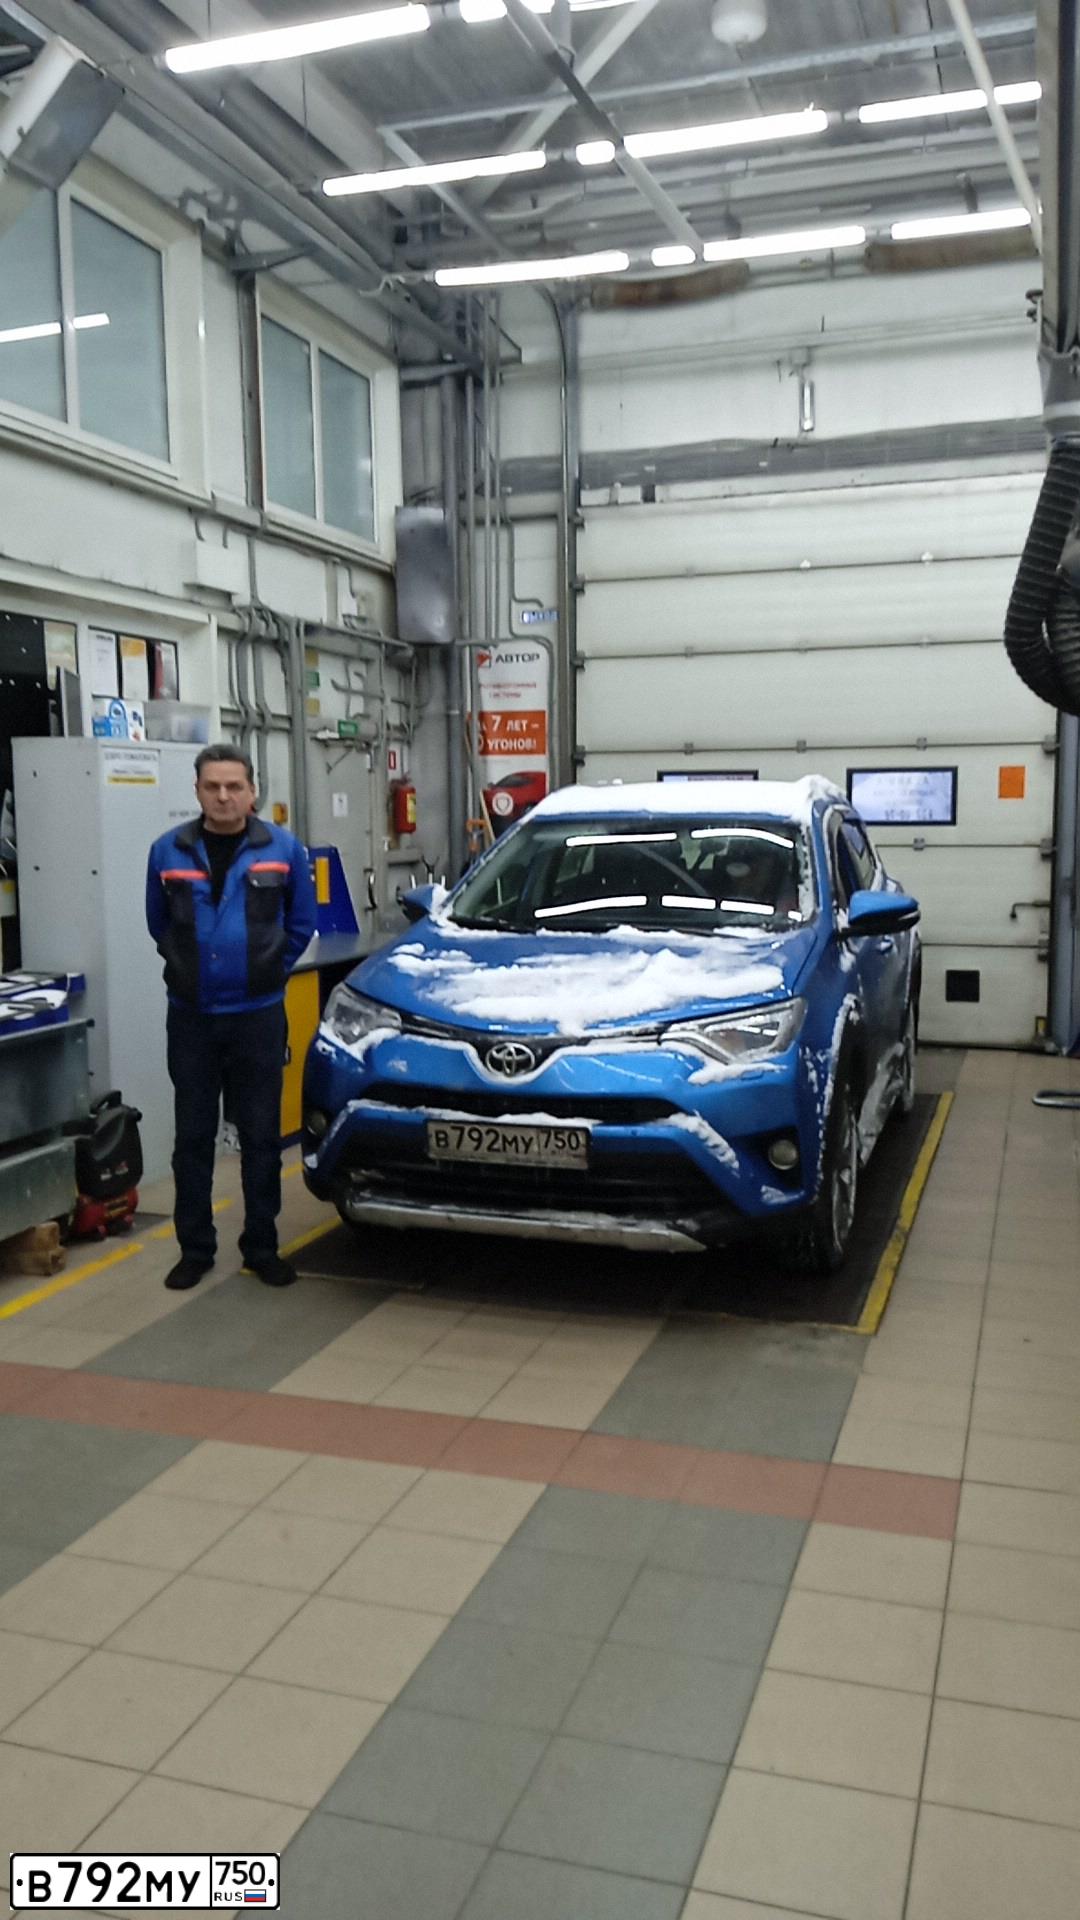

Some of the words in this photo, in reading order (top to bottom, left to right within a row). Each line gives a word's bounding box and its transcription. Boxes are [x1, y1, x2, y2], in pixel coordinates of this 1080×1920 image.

[495, 652, 541, 664] АВТОР
[491, 714, 502, 732] 7
[506, 719, 528, 732] ЛЕТ
[543, 1131, 581, 1151] 750
